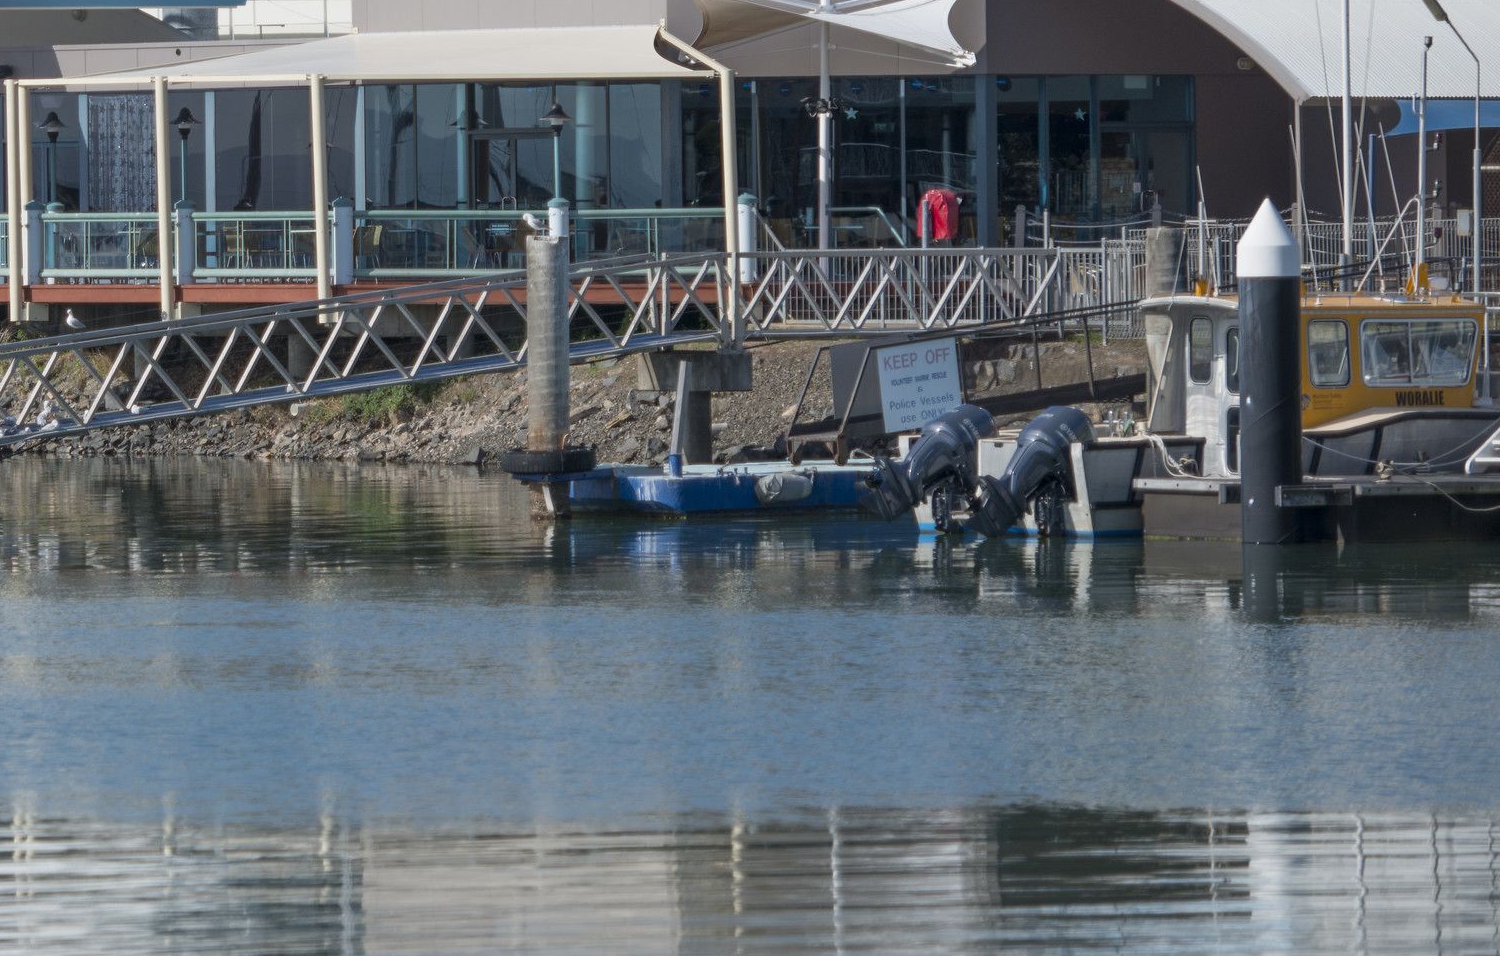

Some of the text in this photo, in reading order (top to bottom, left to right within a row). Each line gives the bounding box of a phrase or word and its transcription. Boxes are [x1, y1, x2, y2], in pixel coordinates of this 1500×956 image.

[883, 347, 950, 372] KEEP OFF
[889, 392, 954, 411] Police Vessels
[1396, 390, 1445, 406] WORALIE
[901, 414, 917, 423] use
